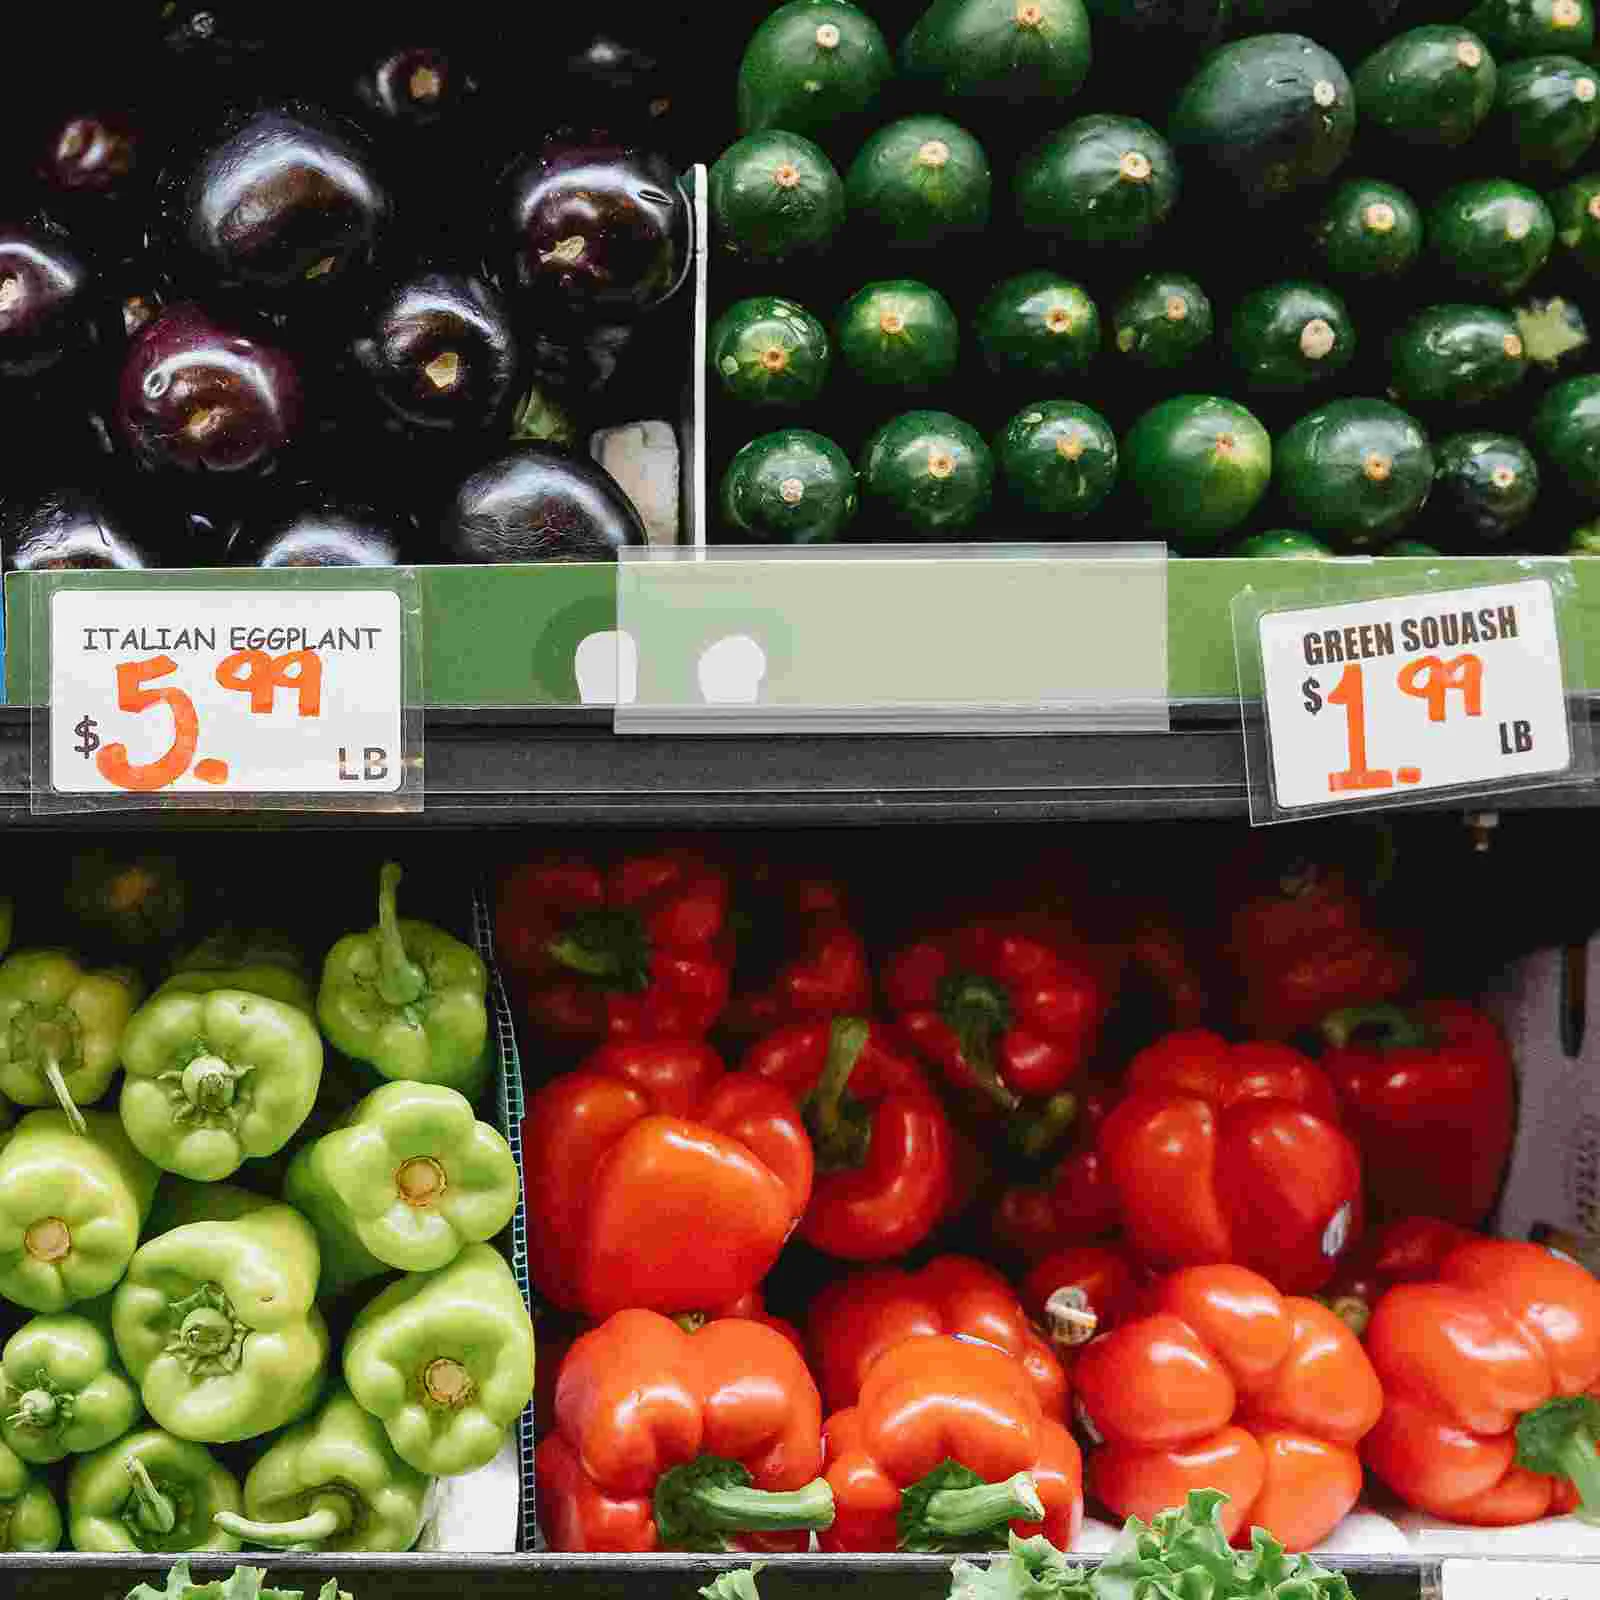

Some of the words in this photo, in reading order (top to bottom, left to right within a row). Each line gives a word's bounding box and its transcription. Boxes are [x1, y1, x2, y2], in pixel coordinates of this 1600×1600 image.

[83, 627, 216, 651] ITALIAN
[230, 627, 382, 651] EGGPLANT
[1302, 622, 1395, 667] GREEN
[1402, 605, 1518, 652] SQUASH
[1499, 720, 1533, 755] LB
[338, 747, 388, 781] LB
